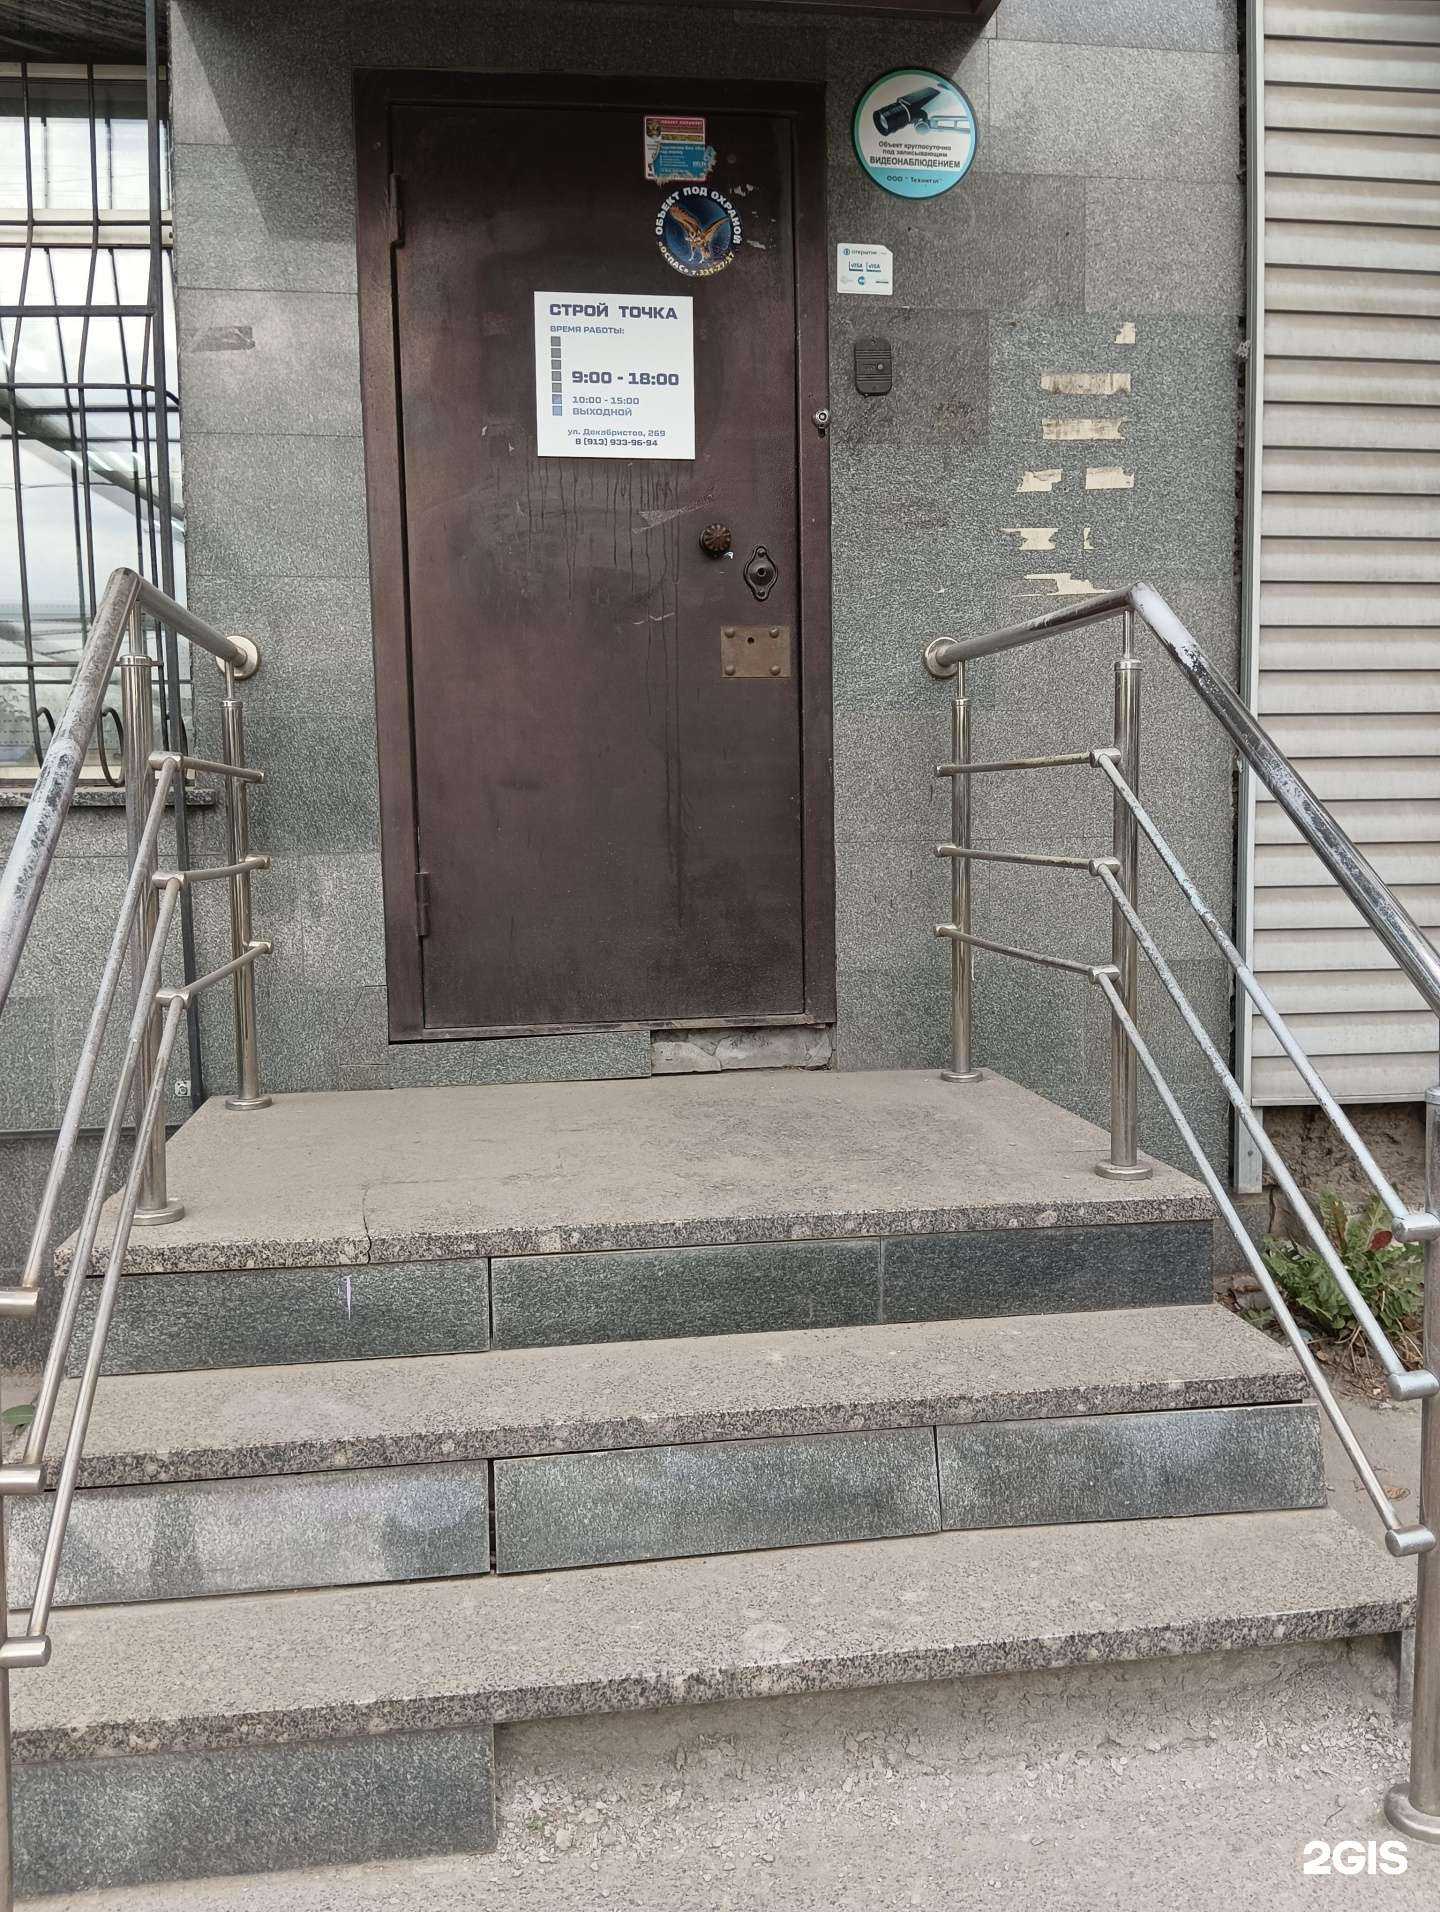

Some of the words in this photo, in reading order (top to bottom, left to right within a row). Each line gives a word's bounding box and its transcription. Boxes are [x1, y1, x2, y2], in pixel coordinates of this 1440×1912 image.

[879, 141, 902, 149] Объект
[870, 156, 960, 168] ВИДЕОНАБЛЮДЕНИЕМ
[886, 175, 902, 183] ООО
[682, 186, 708, 197] ПОД
[711, 191, 743, 245] ОХРАНОЙ
[549, 303, 608, 317] СТРОЙ
[619, 305, 678, 319] ТОЧКА
[550, 325, 582, 333] ВРЕМЯ
[584, 327, 625, 335] РАБОТЫ:
[572, 371, 612, 384] 9:00
[628, 372, 679, 386] 18:00
[572, 396, 602, 404] 10:00
[611, 397, 640, 405] 15:00
[572, 407, 632, 417] ВЫХОДНОЙ
[567, 429, 581, 437] ул.
[583, 429, 646, 438] Декабристов,
[584, 438, 608, 446] (913)
[610, 439, 658, 447] 933-96-94
